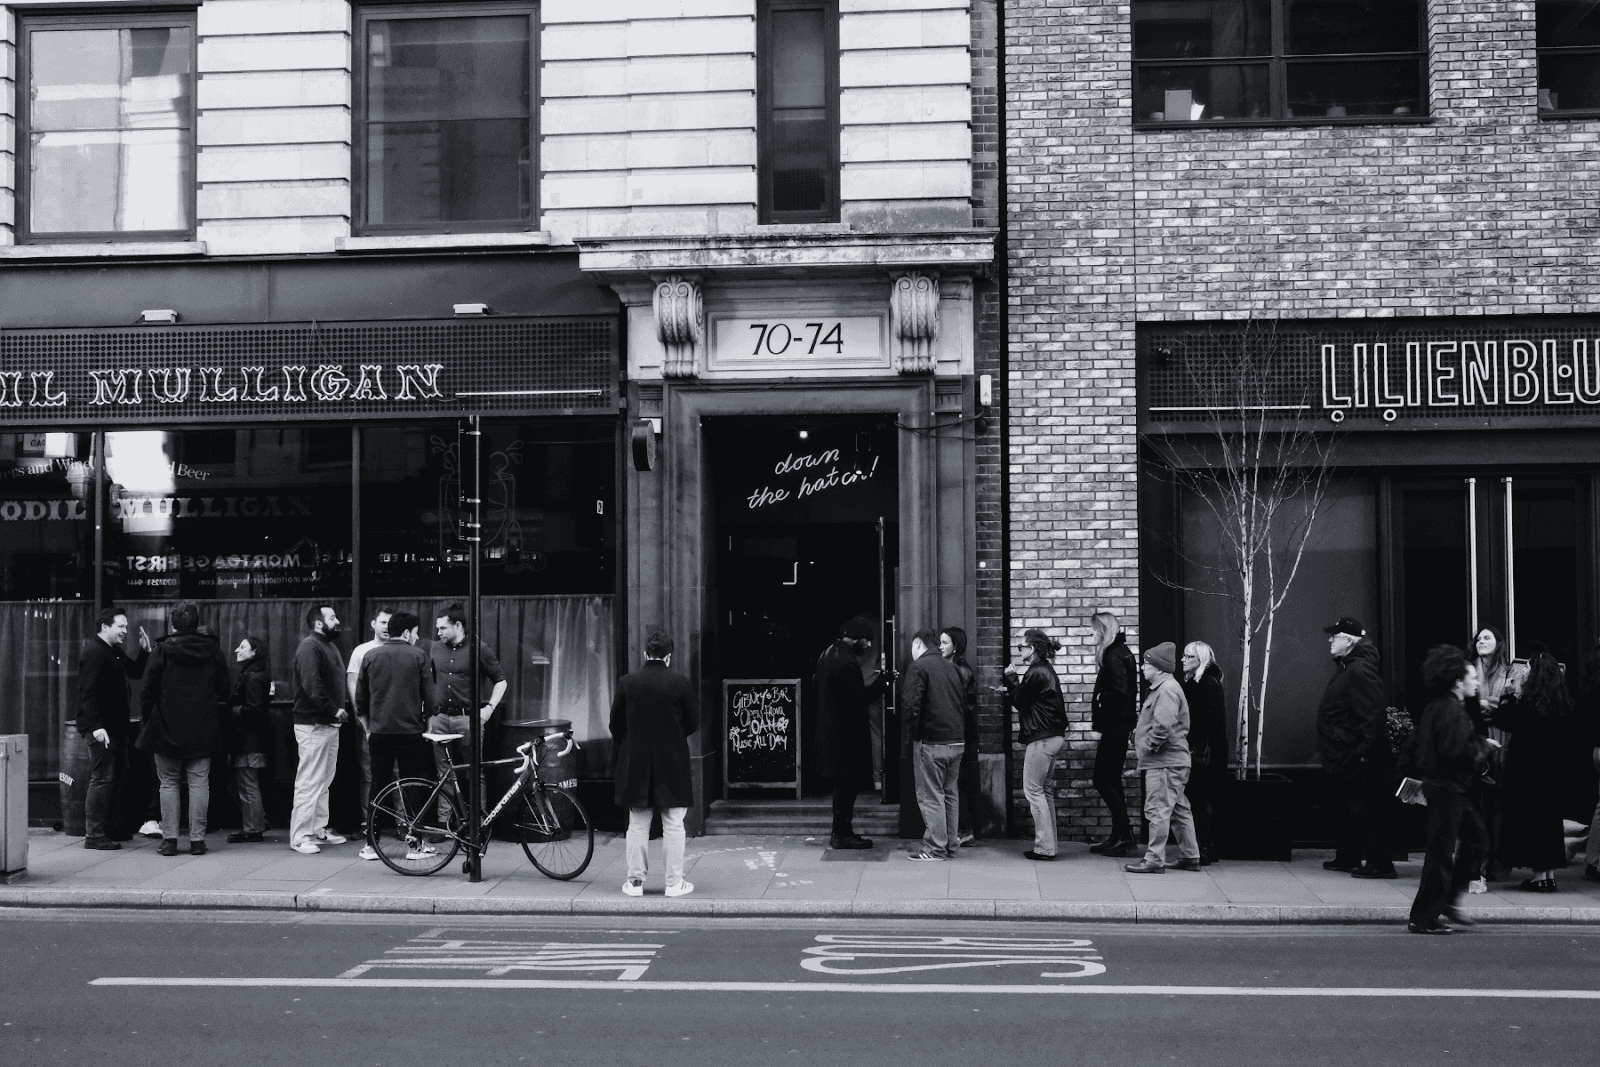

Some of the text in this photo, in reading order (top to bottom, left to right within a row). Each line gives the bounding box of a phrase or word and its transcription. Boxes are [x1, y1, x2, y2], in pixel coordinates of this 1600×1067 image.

[749, 322, 844, 356] 70-74
[89, 363, 444, 406] MULLIGAN
[27, 459, 54, 475] and
[177, 463, 210, 481] Beer
[775, 448, 840, 475] down
[117, 496, 313, 520] MULLIGAN
[747, 486, 790, 509] the
[799, 935, 1107, 978] BUS
